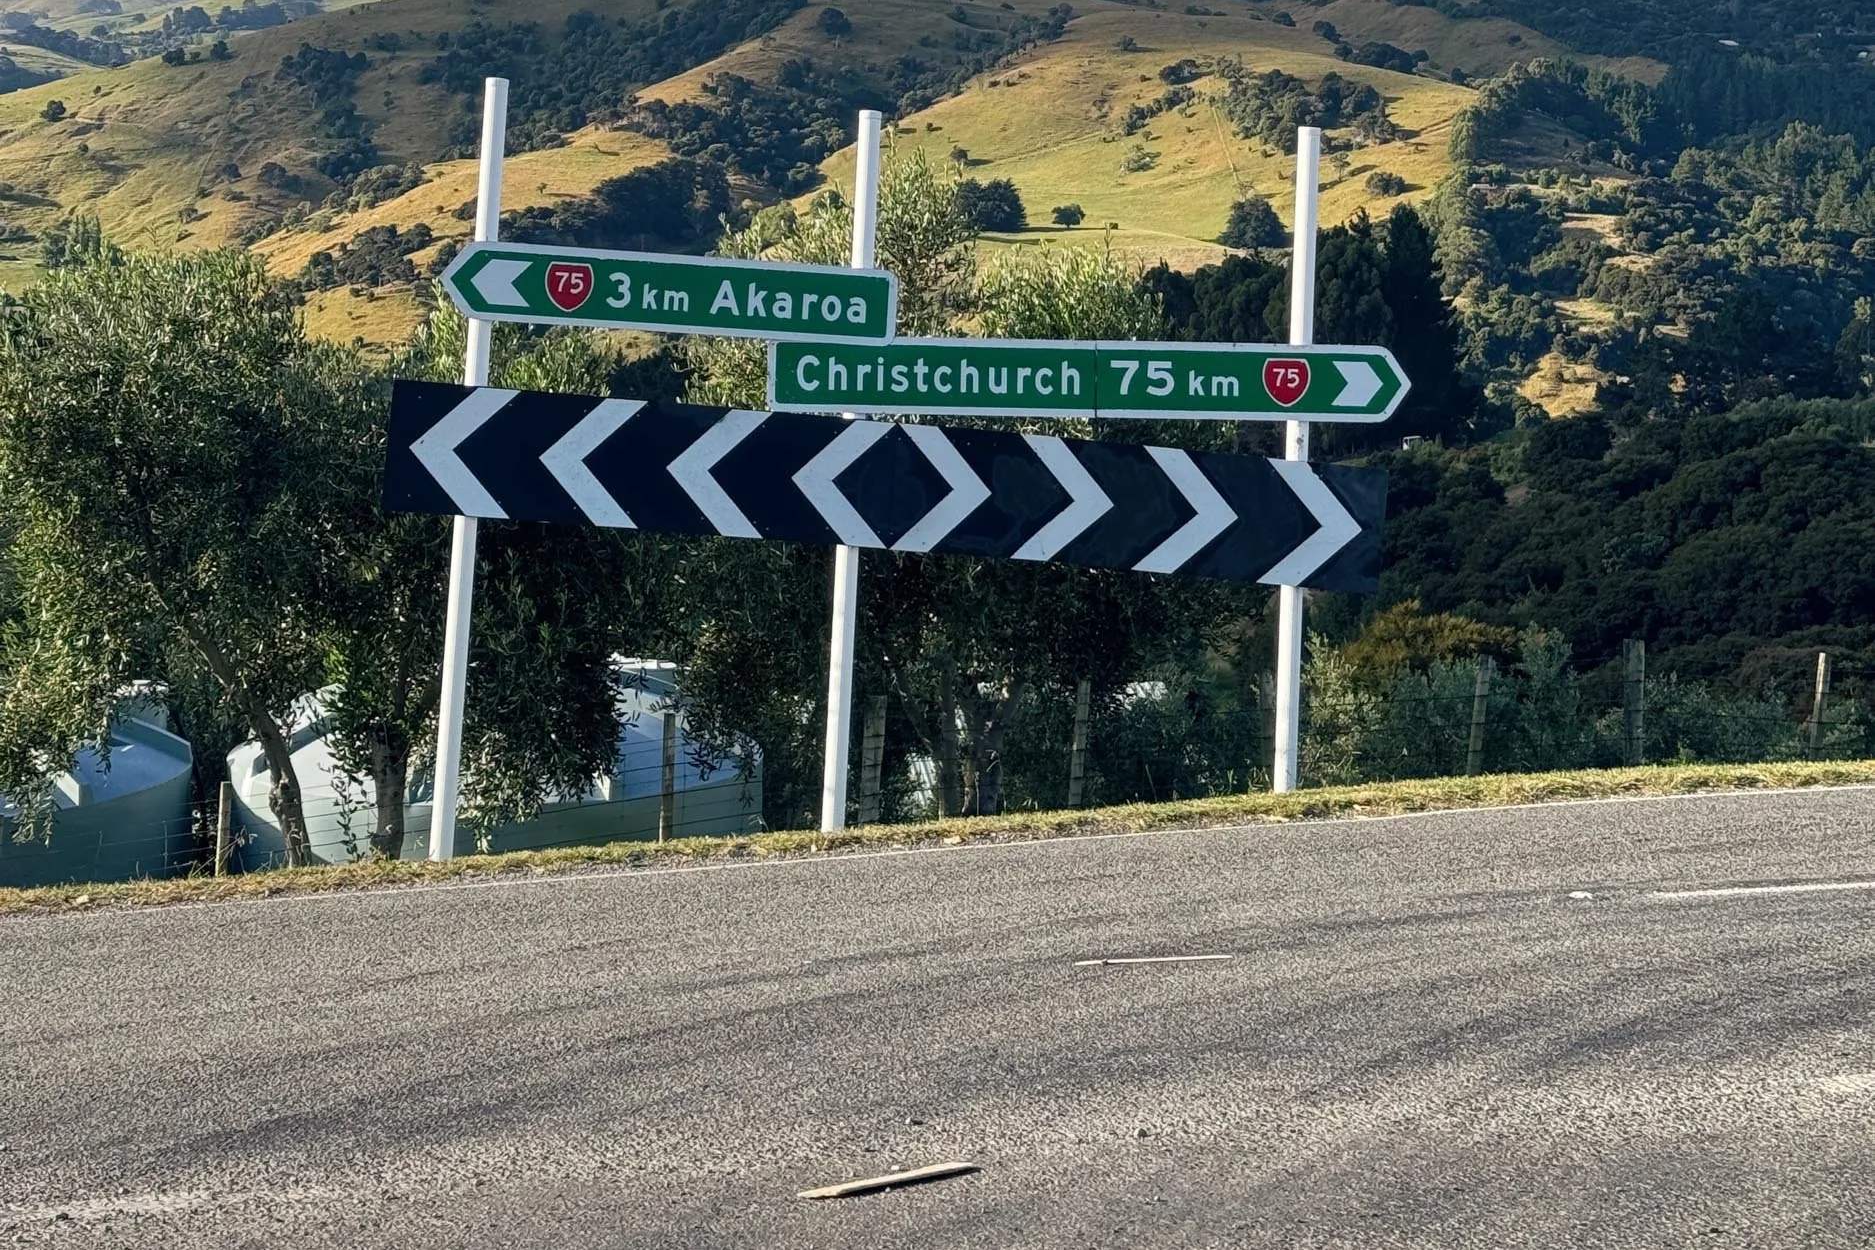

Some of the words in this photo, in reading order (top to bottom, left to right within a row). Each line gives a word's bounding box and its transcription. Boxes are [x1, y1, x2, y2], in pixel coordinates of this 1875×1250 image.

[555, 271, 585, 295] 75
[605, 272, 632, 309] 3
[641, 283, 689, 312] km
[709, 279, 867, 324] Akaroa
[796, 355, 1081, 395] Christchurch
[1110, 360, 1174, 396] 75
[1188, 370, 1239, 397] km
[1272, 368, 1300, 388] 75
